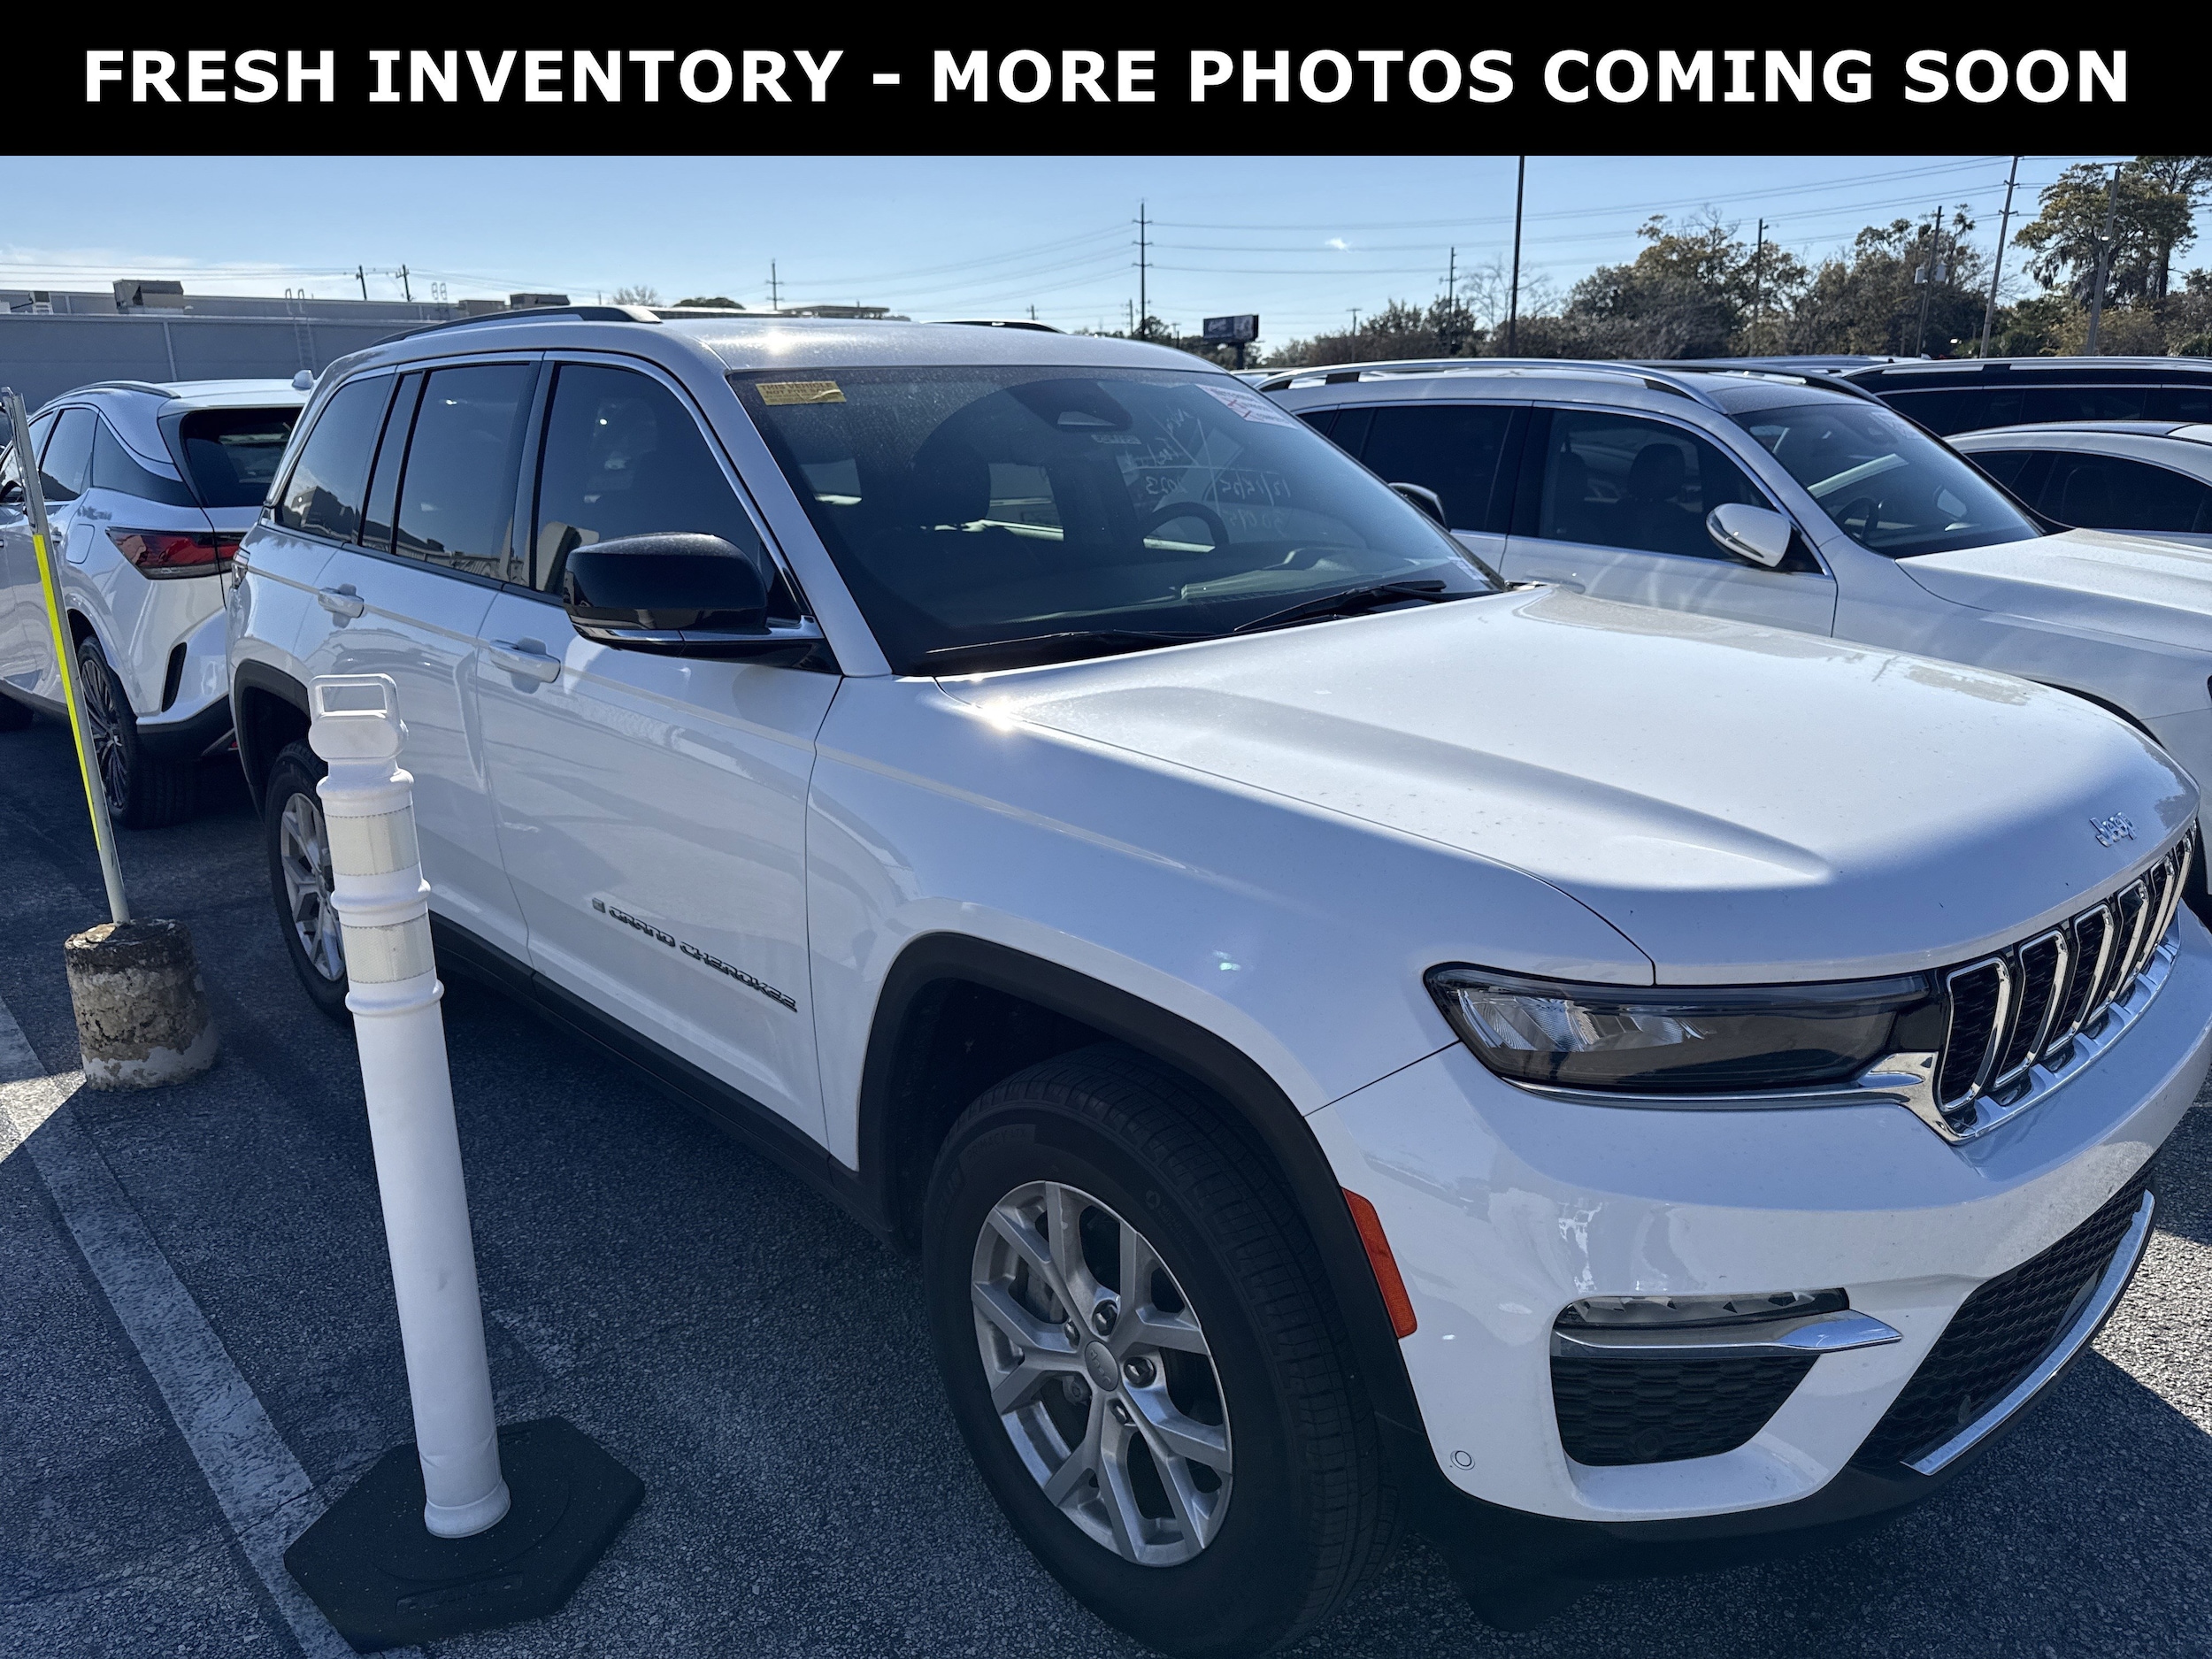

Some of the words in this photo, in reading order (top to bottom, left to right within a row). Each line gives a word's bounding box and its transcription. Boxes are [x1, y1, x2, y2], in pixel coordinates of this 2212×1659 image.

[2089, 811, 2138, 849] Jeep
[608, 905, 676, 948] GRAND
[680, 941, 798, 1013] CHEROKEE
[1090, 1348, 1112, 1386] Jeep
